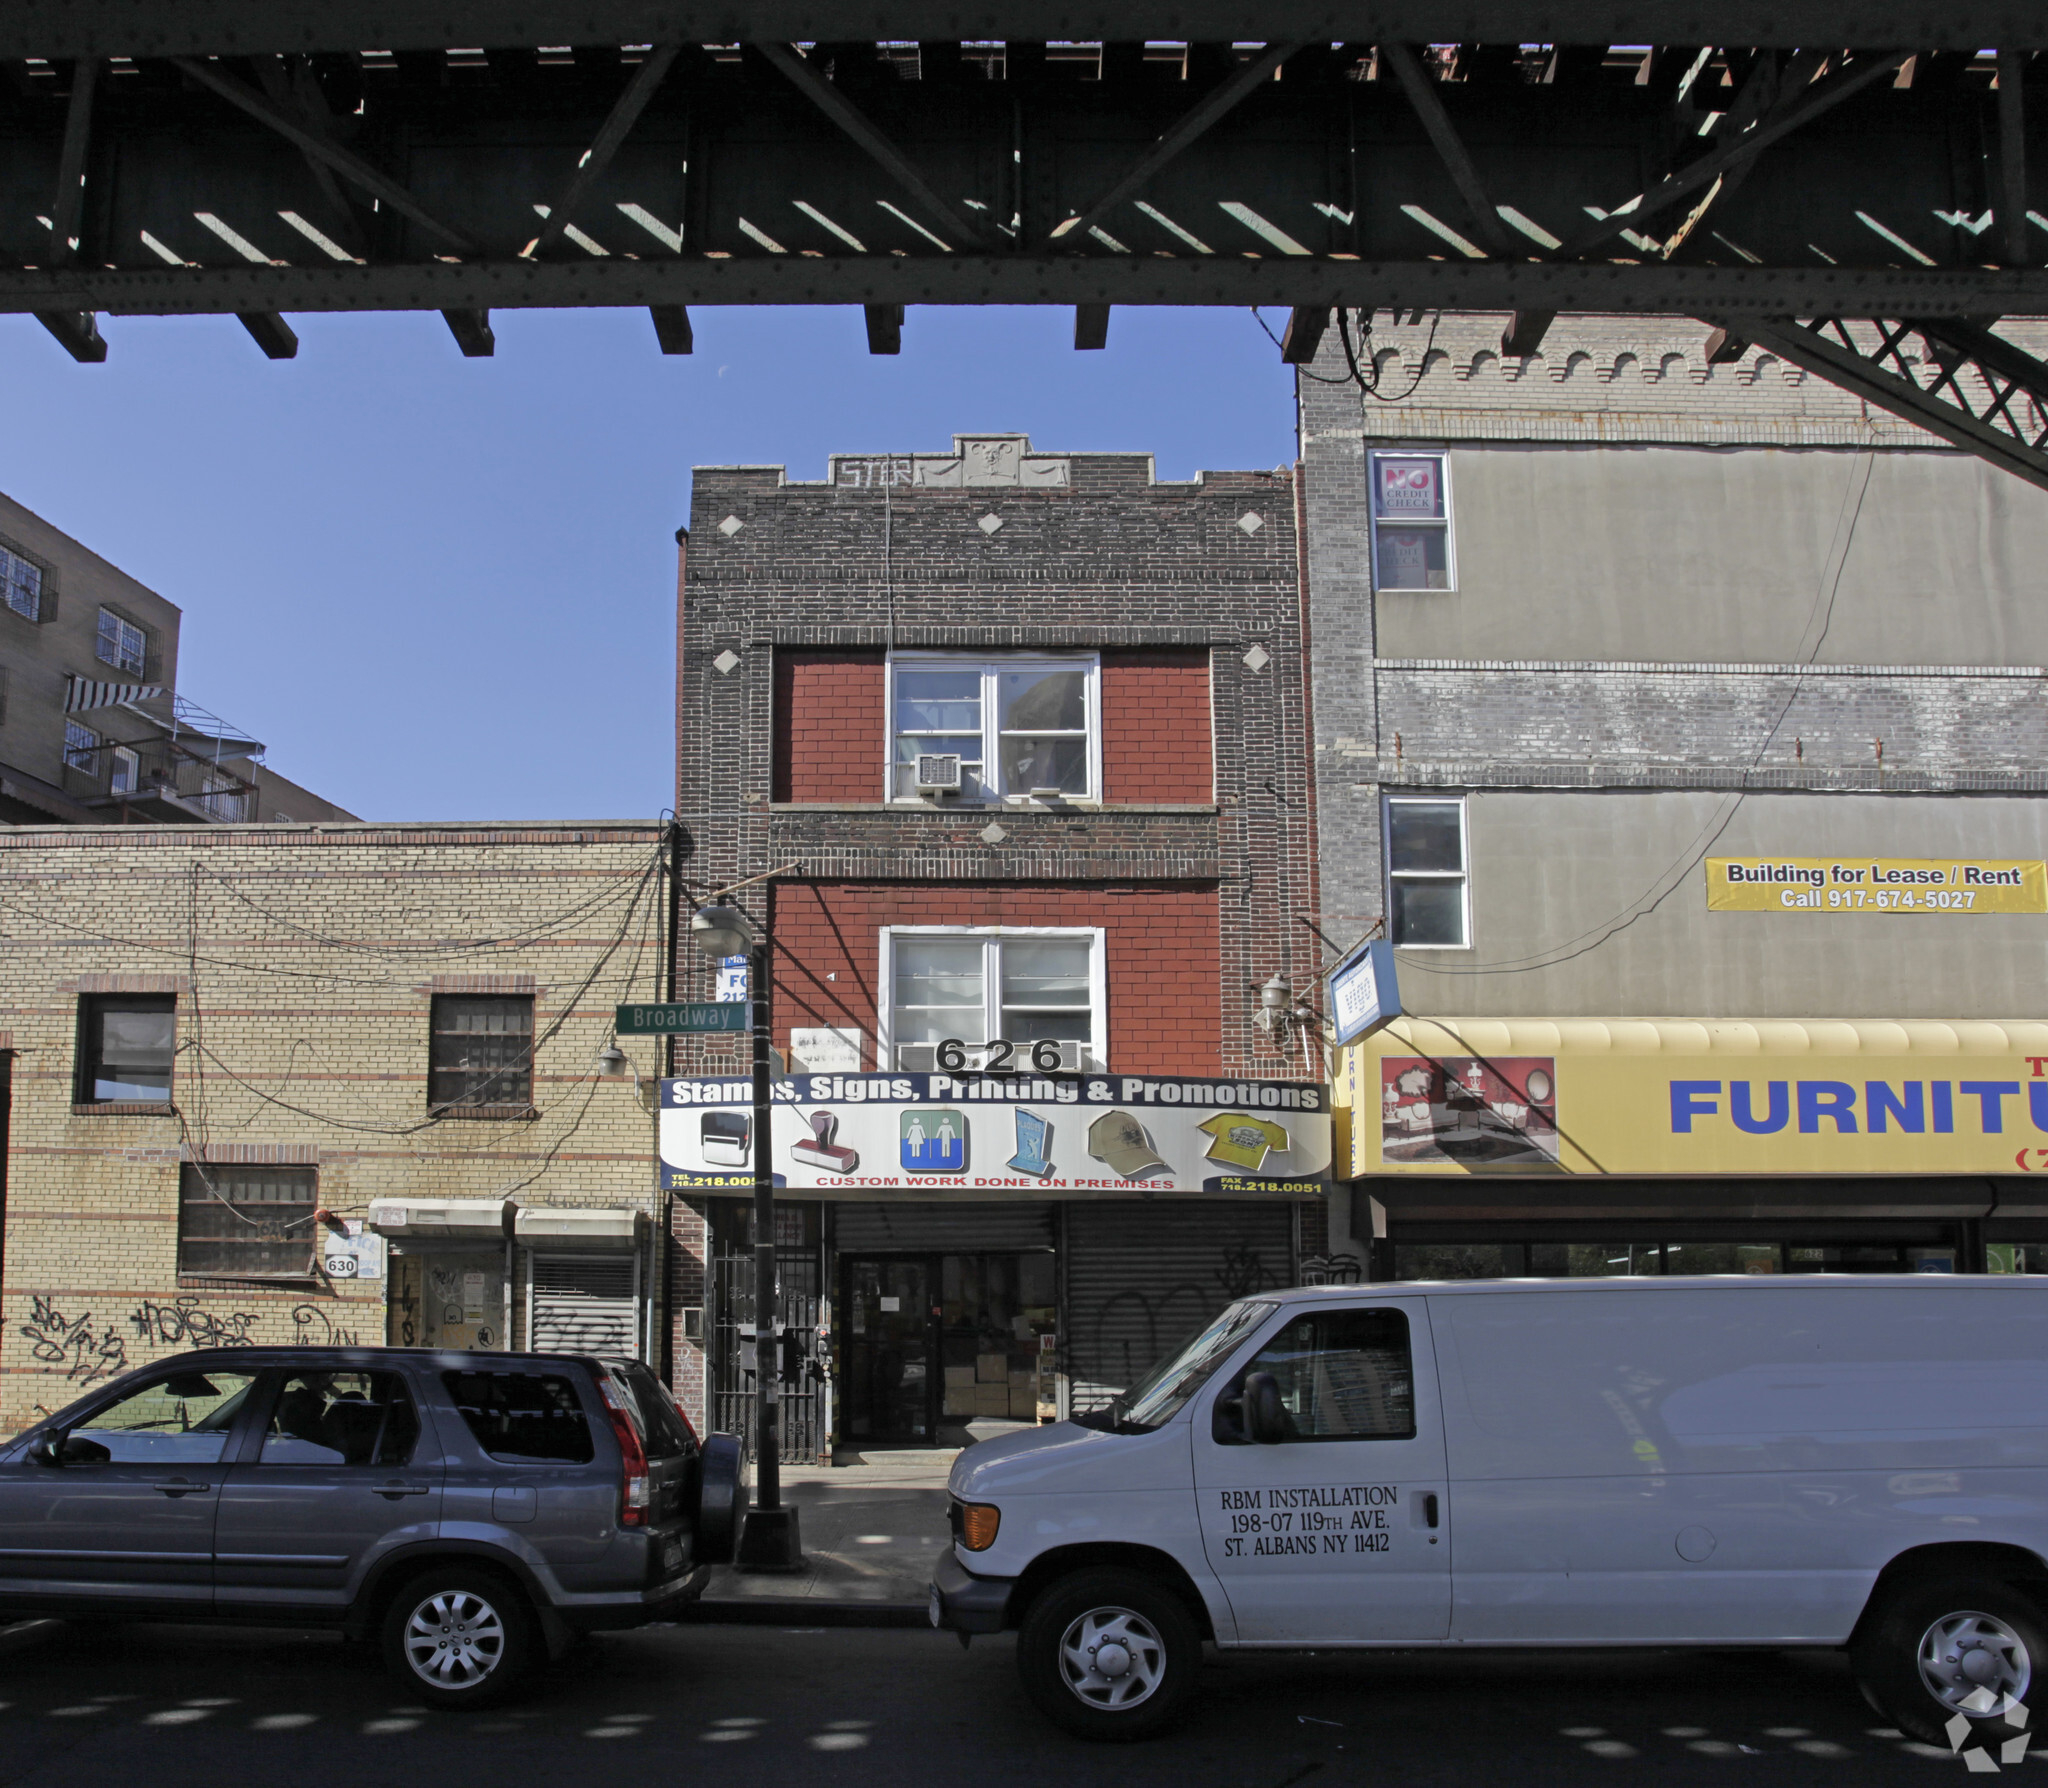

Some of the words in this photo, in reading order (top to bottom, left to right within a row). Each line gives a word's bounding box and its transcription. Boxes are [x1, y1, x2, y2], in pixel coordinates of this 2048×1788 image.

[1386, 470, 1429, 489] NO
[1387, 490, 1429, 498] CREDIT
[1387, 499, 1429, 507] CHECK
[1727, 864, 1825, 886] Building
[1831, 865, 1865, 883] for
[1872, 866, 1944, 884] Lease
[1964, 867, 2021, 885] Rent
[1780, 890, 1822, 907] Call
[1828, 890, 1976, 909] 917-674-5027
[633, 1005, 731, 1030] Broadway
[936, 1038, 1063, 1073] 626
[672, 1078, 803, 1104] Stams,
[810, 1076, 920, 1102] Signs,
[929, 1076, 1079, 1103] Printing
[1087, 1080, 1114, 1101] &
[1121, 1078, 1319, 1109] Promotions
[816, 1177, 899, 1186] CUSTOM
[906, 1178, 966, 1186] WORK
[974, 1178, 1031, 1187] DONE
[1038, 1178, 1067, 1187] ON
[1074, 1179, 1175, 1189] PREMISES
[1220, 1181, 1322, 1193] 718.218.0051
[328, 1260, 355, 1272] 630
[1221, 1490, 1261, 1510] RBM
[1269, 1486, 1397, 1509] INSTALLATION
[1232, 1513, 1293, 1533] 198-07
[1301, 1511, 1343, 1531] 119TH
[1350, 1510, 1390, 1529] AVE.
[1225, 1538, 1247, 1557] ST.
[1254, 1536, 1317, 1556] ALBANS
[1323, 1535, 1348, 1554] NY
[1354, 1533, 1390, 1553] 11412
